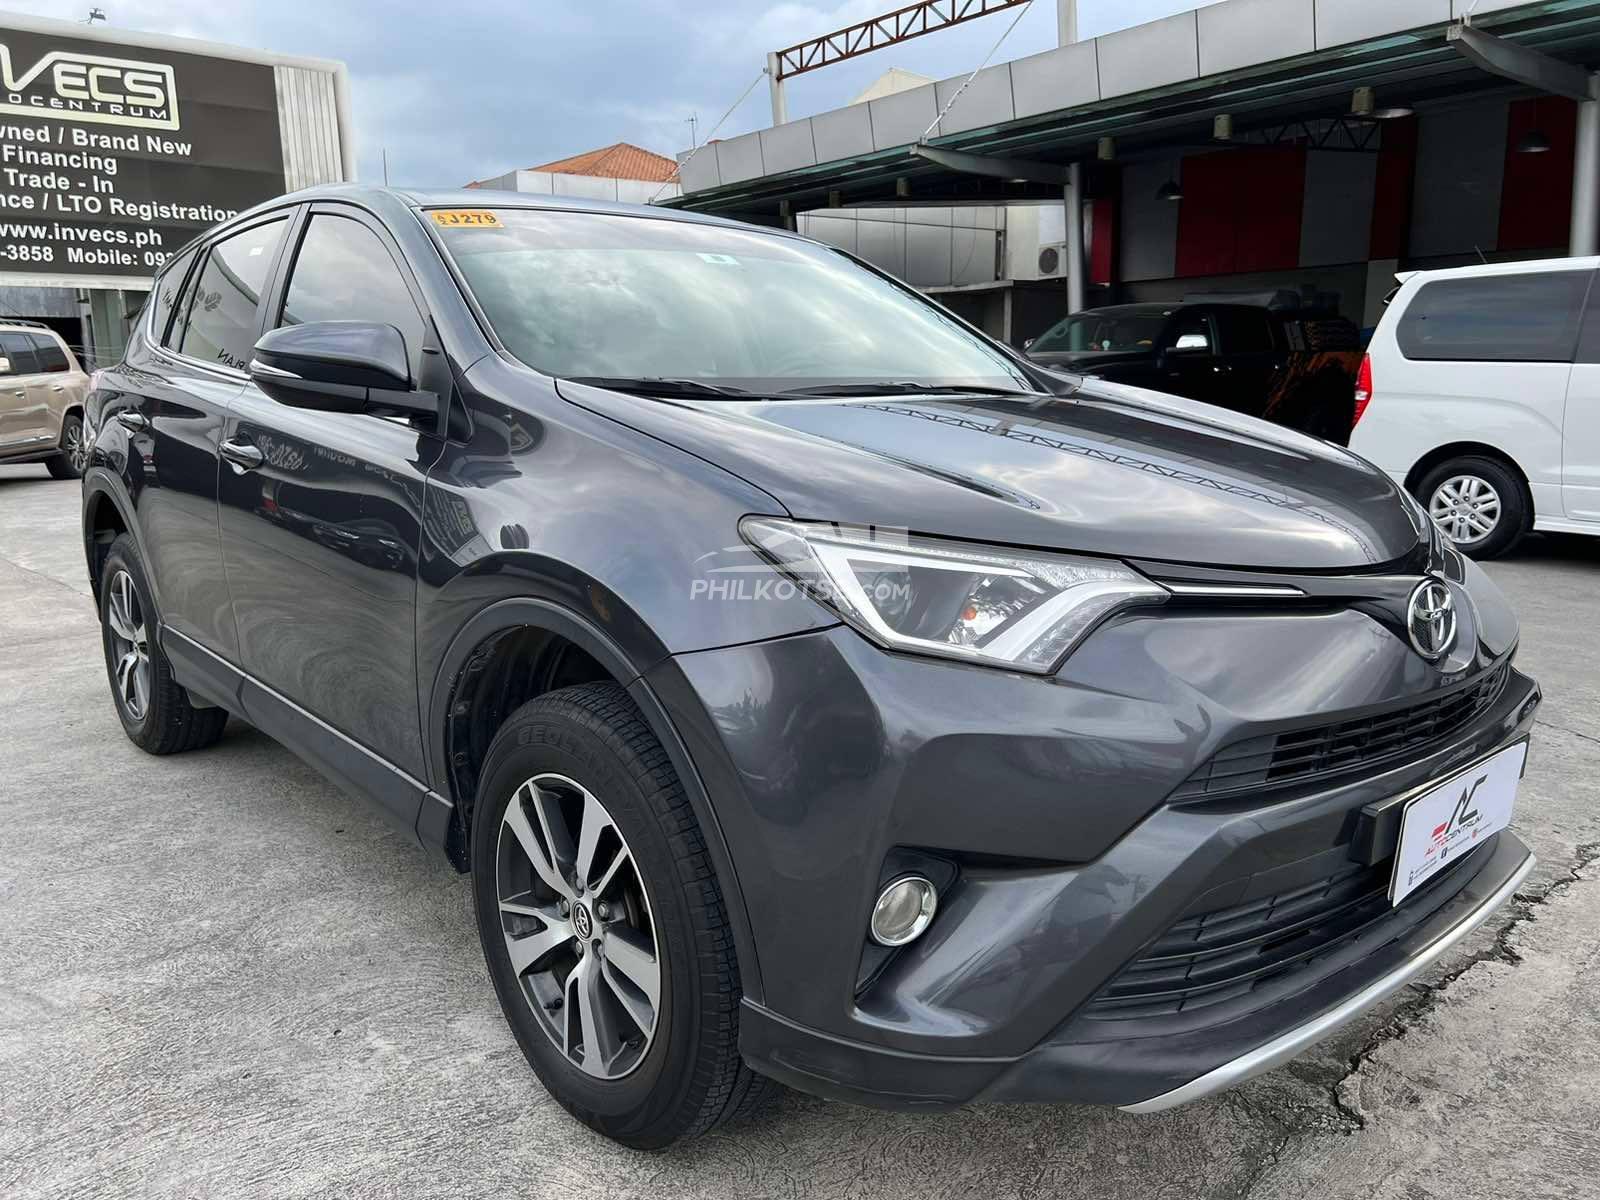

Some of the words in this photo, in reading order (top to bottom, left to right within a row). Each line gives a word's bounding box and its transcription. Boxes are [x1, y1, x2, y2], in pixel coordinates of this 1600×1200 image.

[72, 128, 140, 154] Brand
[146, 138, 192, 156] New
[2, 144, 118, 175] Financing
[3, 167, 71, 191] Trade
[92, 175, 114, 194] In
[56, 194, 102, 213] LTO
[109, 197, 238, 221] Registration
[67, 247, 138, 266] Mobile:
